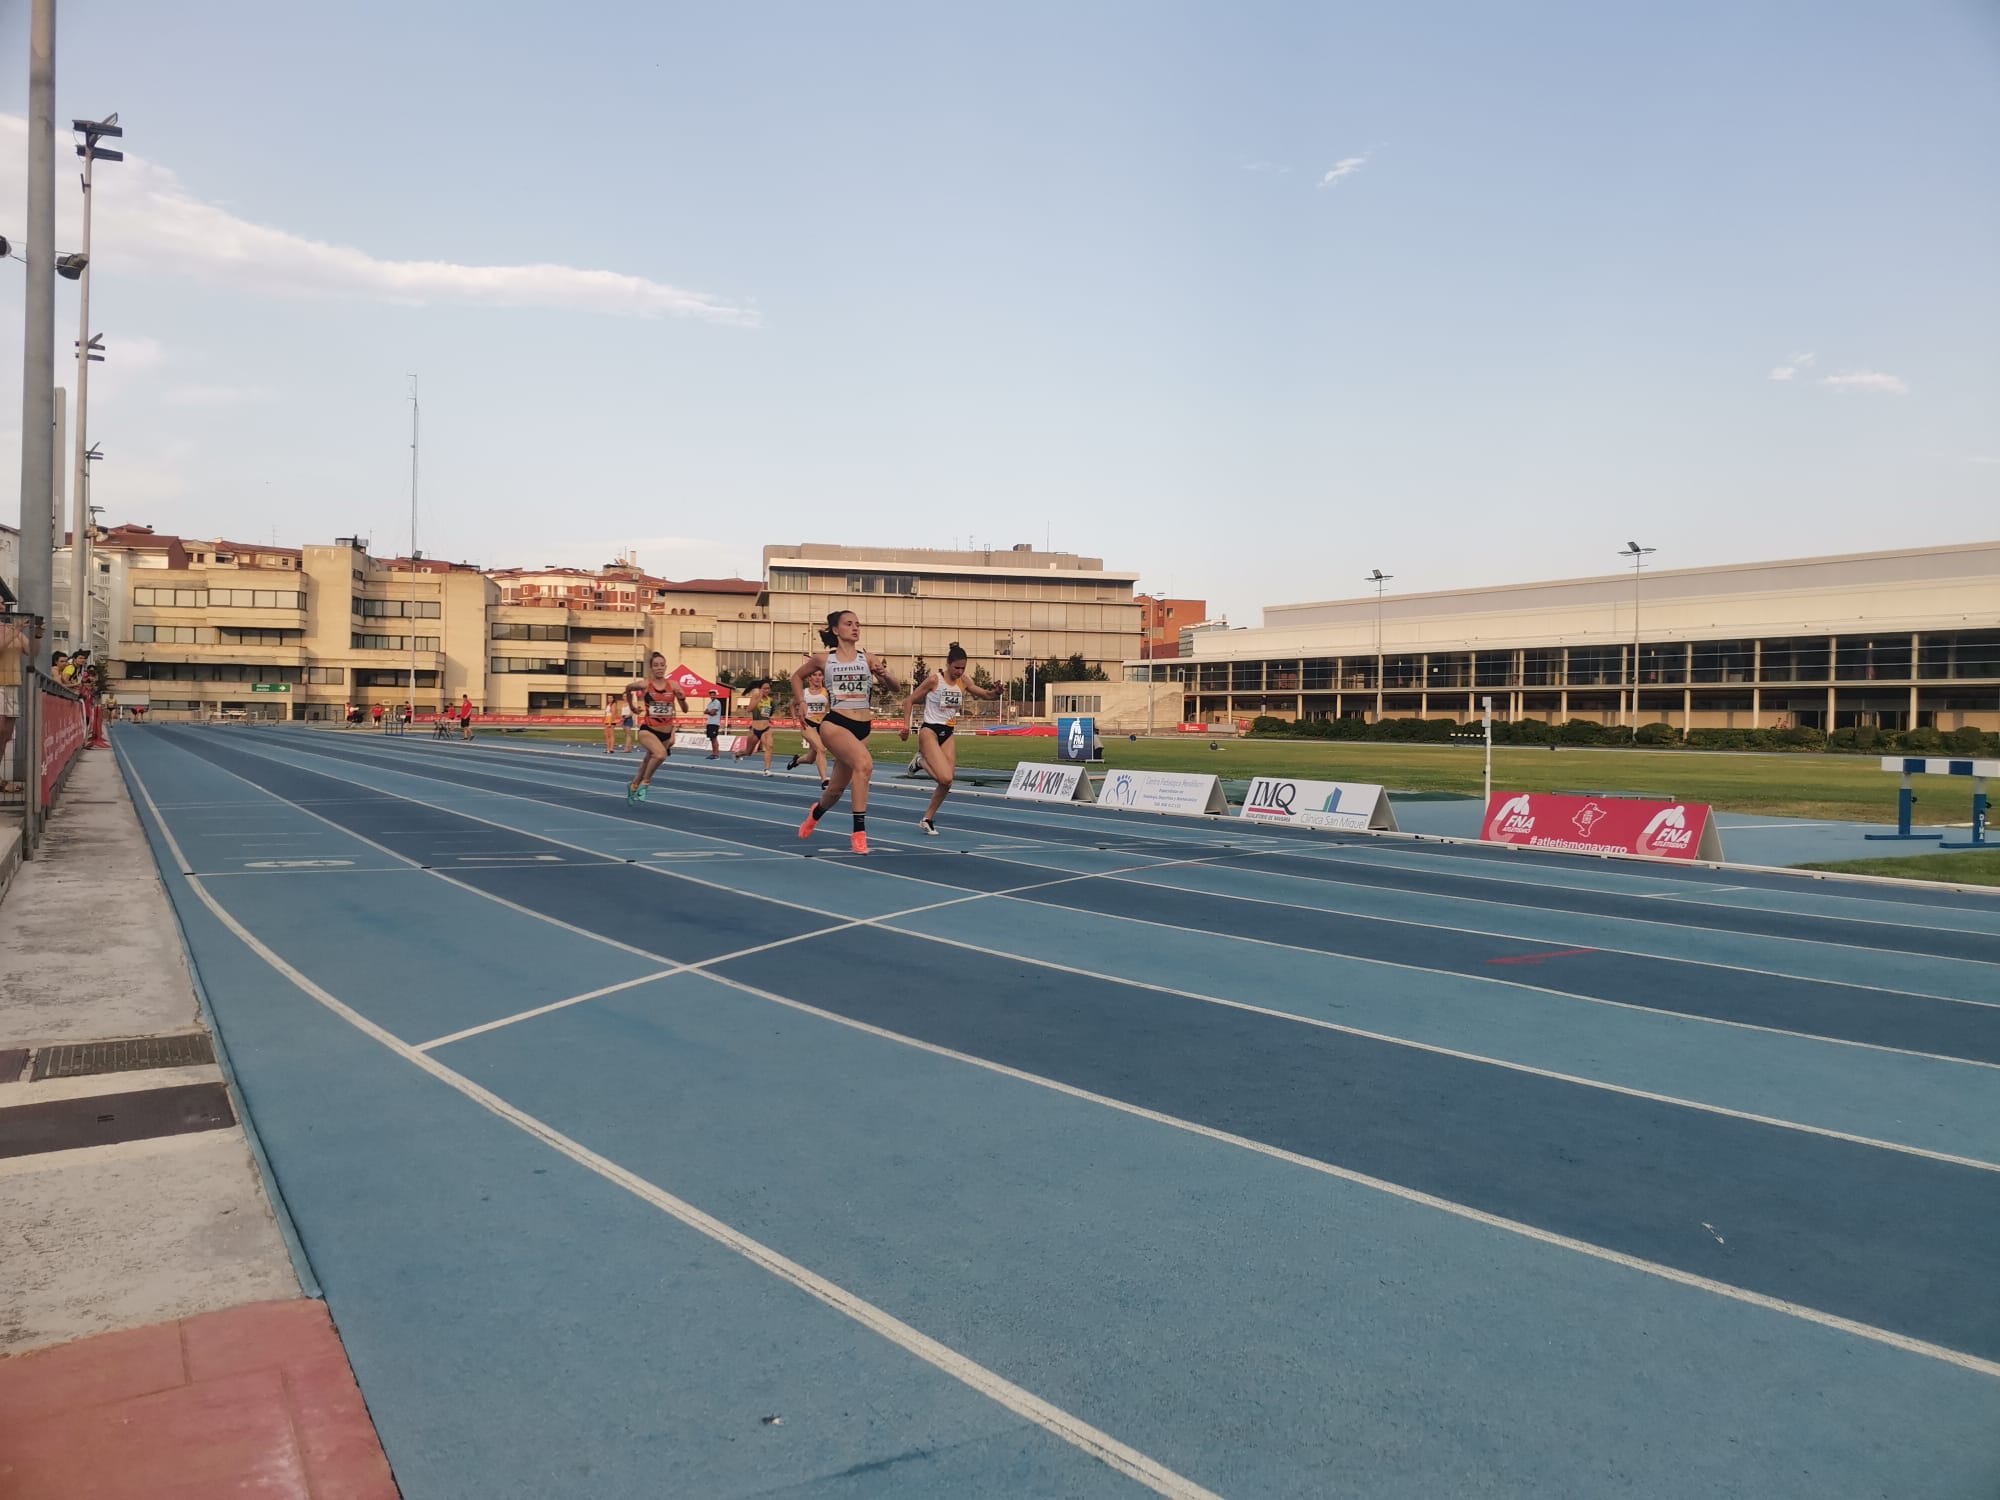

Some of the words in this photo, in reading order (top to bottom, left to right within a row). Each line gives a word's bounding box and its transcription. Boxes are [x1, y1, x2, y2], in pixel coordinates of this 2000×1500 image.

[839, 682, 863, 692] 404
[653, 706, 669, 714] 225
[1019, 769, 1065, 796] A4XKM
[1250, 781, 1296, 815] IMQ
[1324, 815, 1338, 826] San
[1505, 815, 1535, 829] FNA
[1502, 826, 1531, 834] ATLETISMO
[1656, 828, 1693, 844] FNA
[1530, 835, 1627, 854] #atletismonavarro
[1652, 840, 1688, 849] ATLETISMO
